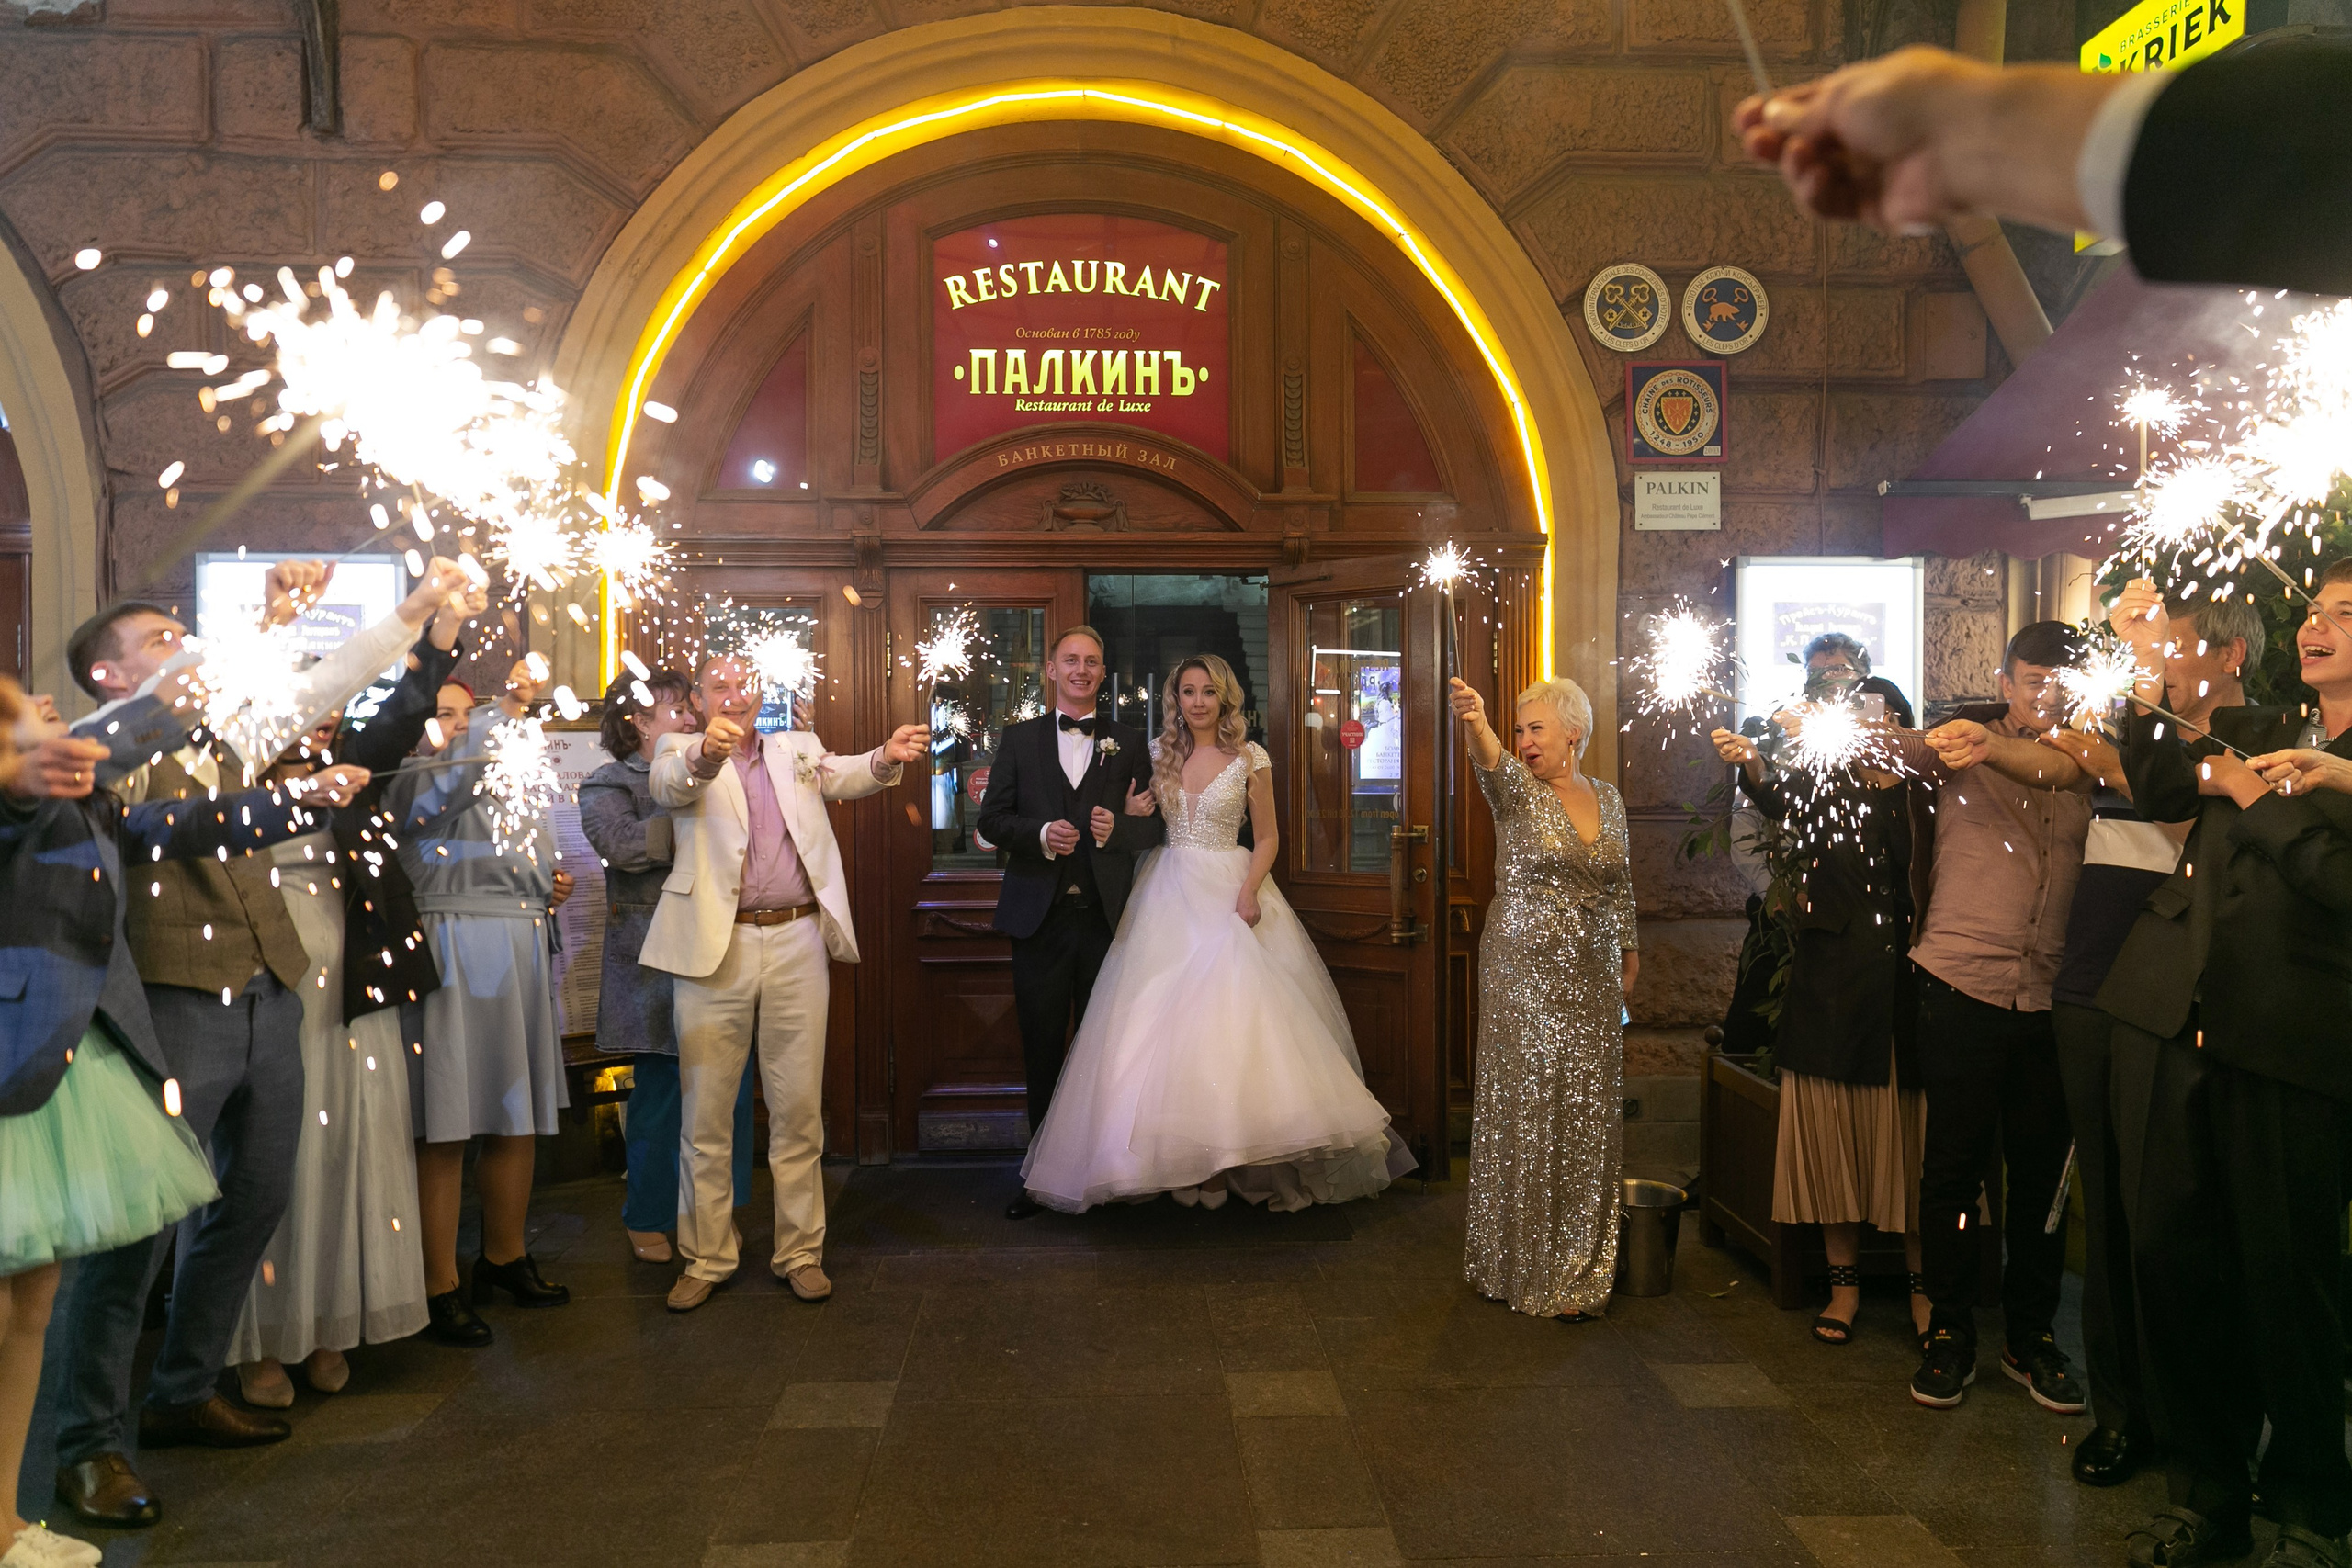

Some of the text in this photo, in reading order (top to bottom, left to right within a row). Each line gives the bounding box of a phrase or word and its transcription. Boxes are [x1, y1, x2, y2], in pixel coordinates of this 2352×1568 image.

[2120, 0, 2191, 53] BRASSERIE
[1621, 265, 1634, 274] DES
[1634, 266, 1667, 297] CONCIERGES
[943, 260, 1221, 311] RESTAURANT
[1588, 266, 1621, 309] INTERNATIONALE
[1685, 269, 1766, 310] ЗОЛОТЫЕ КЛЮЧИ КОНСЬЕРЖЕЙ
[1588, 309, 1601, 330] UNION
[1015, 327, 1069, 339] Основан
[1083, 328, 1113, 339] 1785
[1114, 329, 1141, 342] году
[1602, 333, 1615, 344] LES
[1614, 339, 1633, 347] CLEFS
[1701, 336, 1713, 347] LES
[1713, 341, 1733, 350] CLEFS
[1015, 399, 1152, 412] Restaurant de Luxe
[1642, 384, 1659, 413] CHAINE
[1677, 377, 1713, 412] ROTISSEURS
[997, 443, 1177, 470] БАНКЕТНЫЙ ЗАЛ
[1646, 482, 1709, 494] PALKIN
